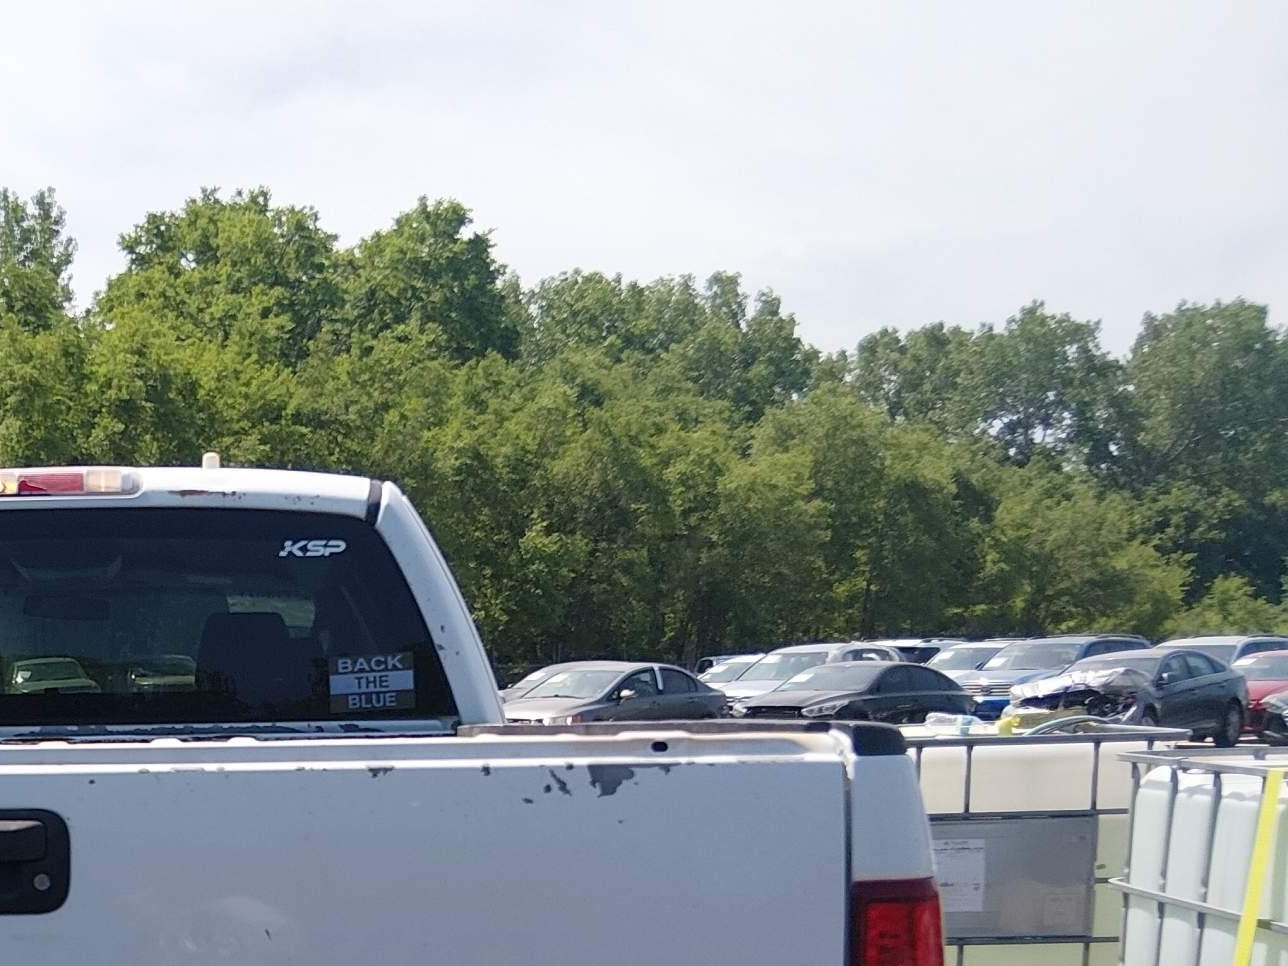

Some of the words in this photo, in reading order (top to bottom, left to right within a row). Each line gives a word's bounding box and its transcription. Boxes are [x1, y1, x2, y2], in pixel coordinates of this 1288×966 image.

[278, 540, 347, 557] KSP
[337, 656, 404, 673] BACK
[354, 674, 390, 689] THE
[348, 692, 397, 709] BLUE
